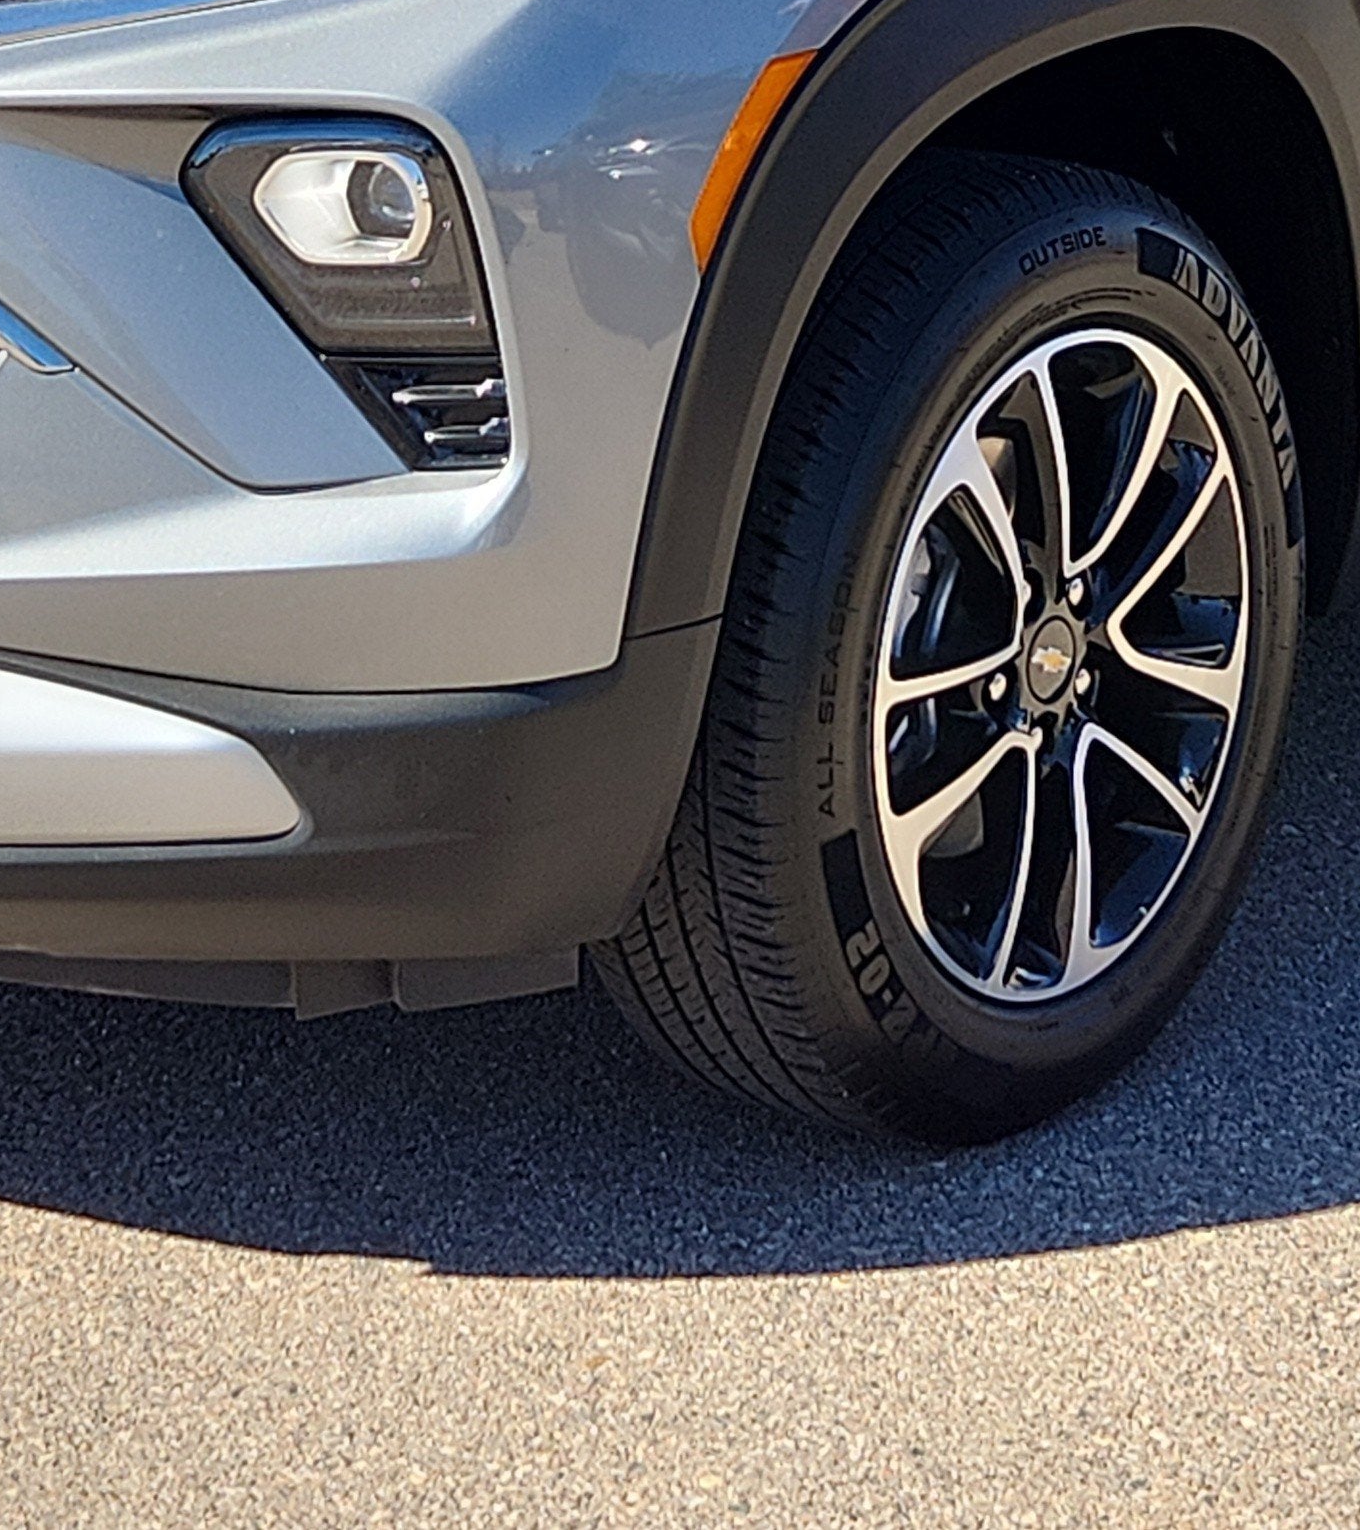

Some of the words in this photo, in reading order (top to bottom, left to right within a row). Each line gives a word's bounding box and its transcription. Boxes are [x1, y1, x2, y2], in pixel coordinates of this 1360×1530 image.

[1018, 226, 1107, 276] OUTSIDE
[1171, 246, 1296, 492] ADVANTA
[817, 550, 861, 726] SEASON
[816, 740, 836, 818] ALL
